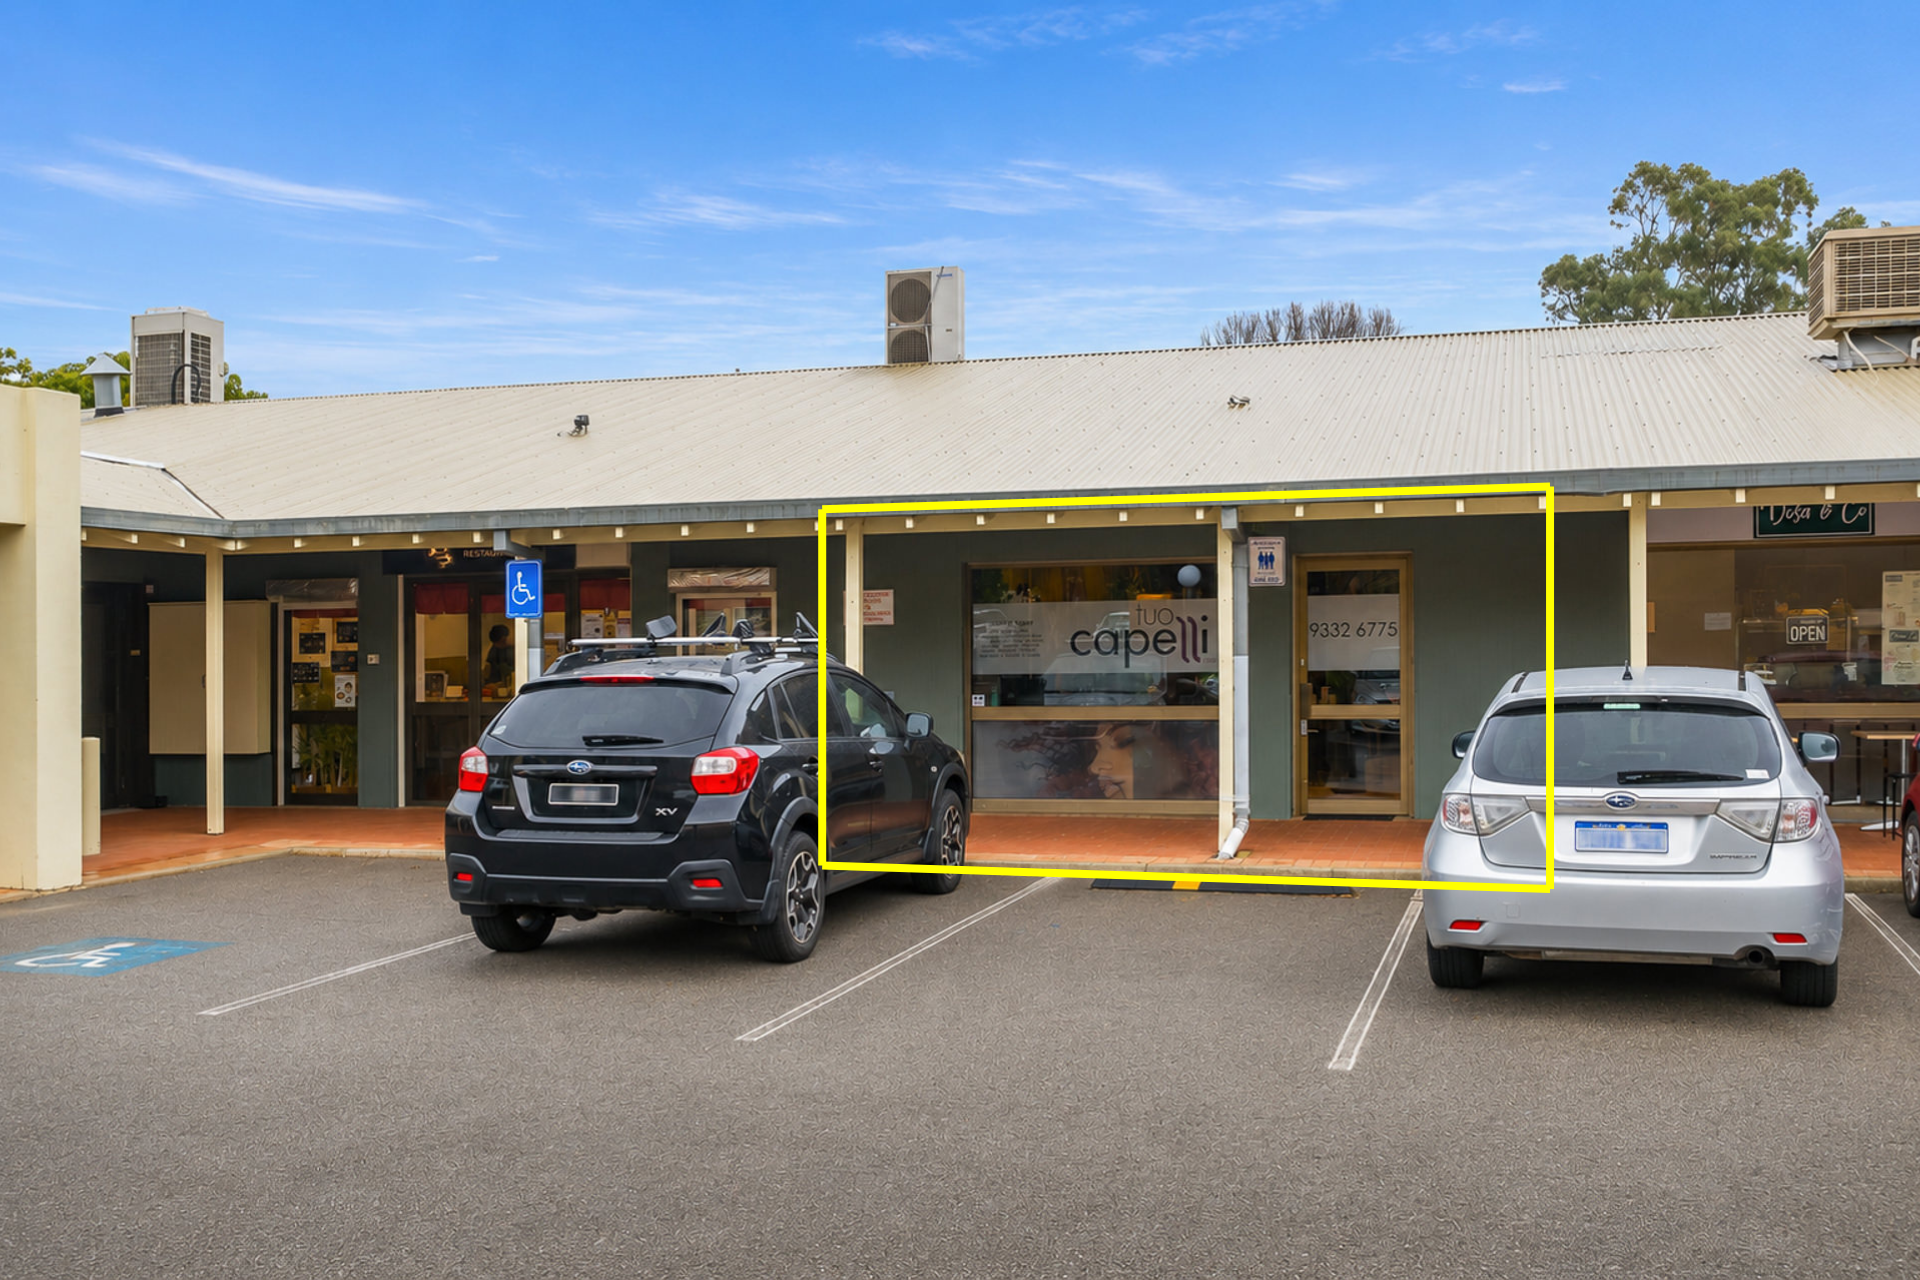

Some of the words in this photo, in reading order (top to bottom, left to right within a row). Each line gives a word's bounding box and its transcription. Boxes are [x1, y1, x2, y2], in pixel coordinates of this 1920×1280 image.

[1136, 603, 1174, 626] tuo
[1309, 622, 1351, 638] 9332
[1356, 621, 1398, 637] 6775
[1790, 625, 1826, 641] OPEN
[1070, 615, 1208, 668] capelli
[655, 808, 678, 816] XV
